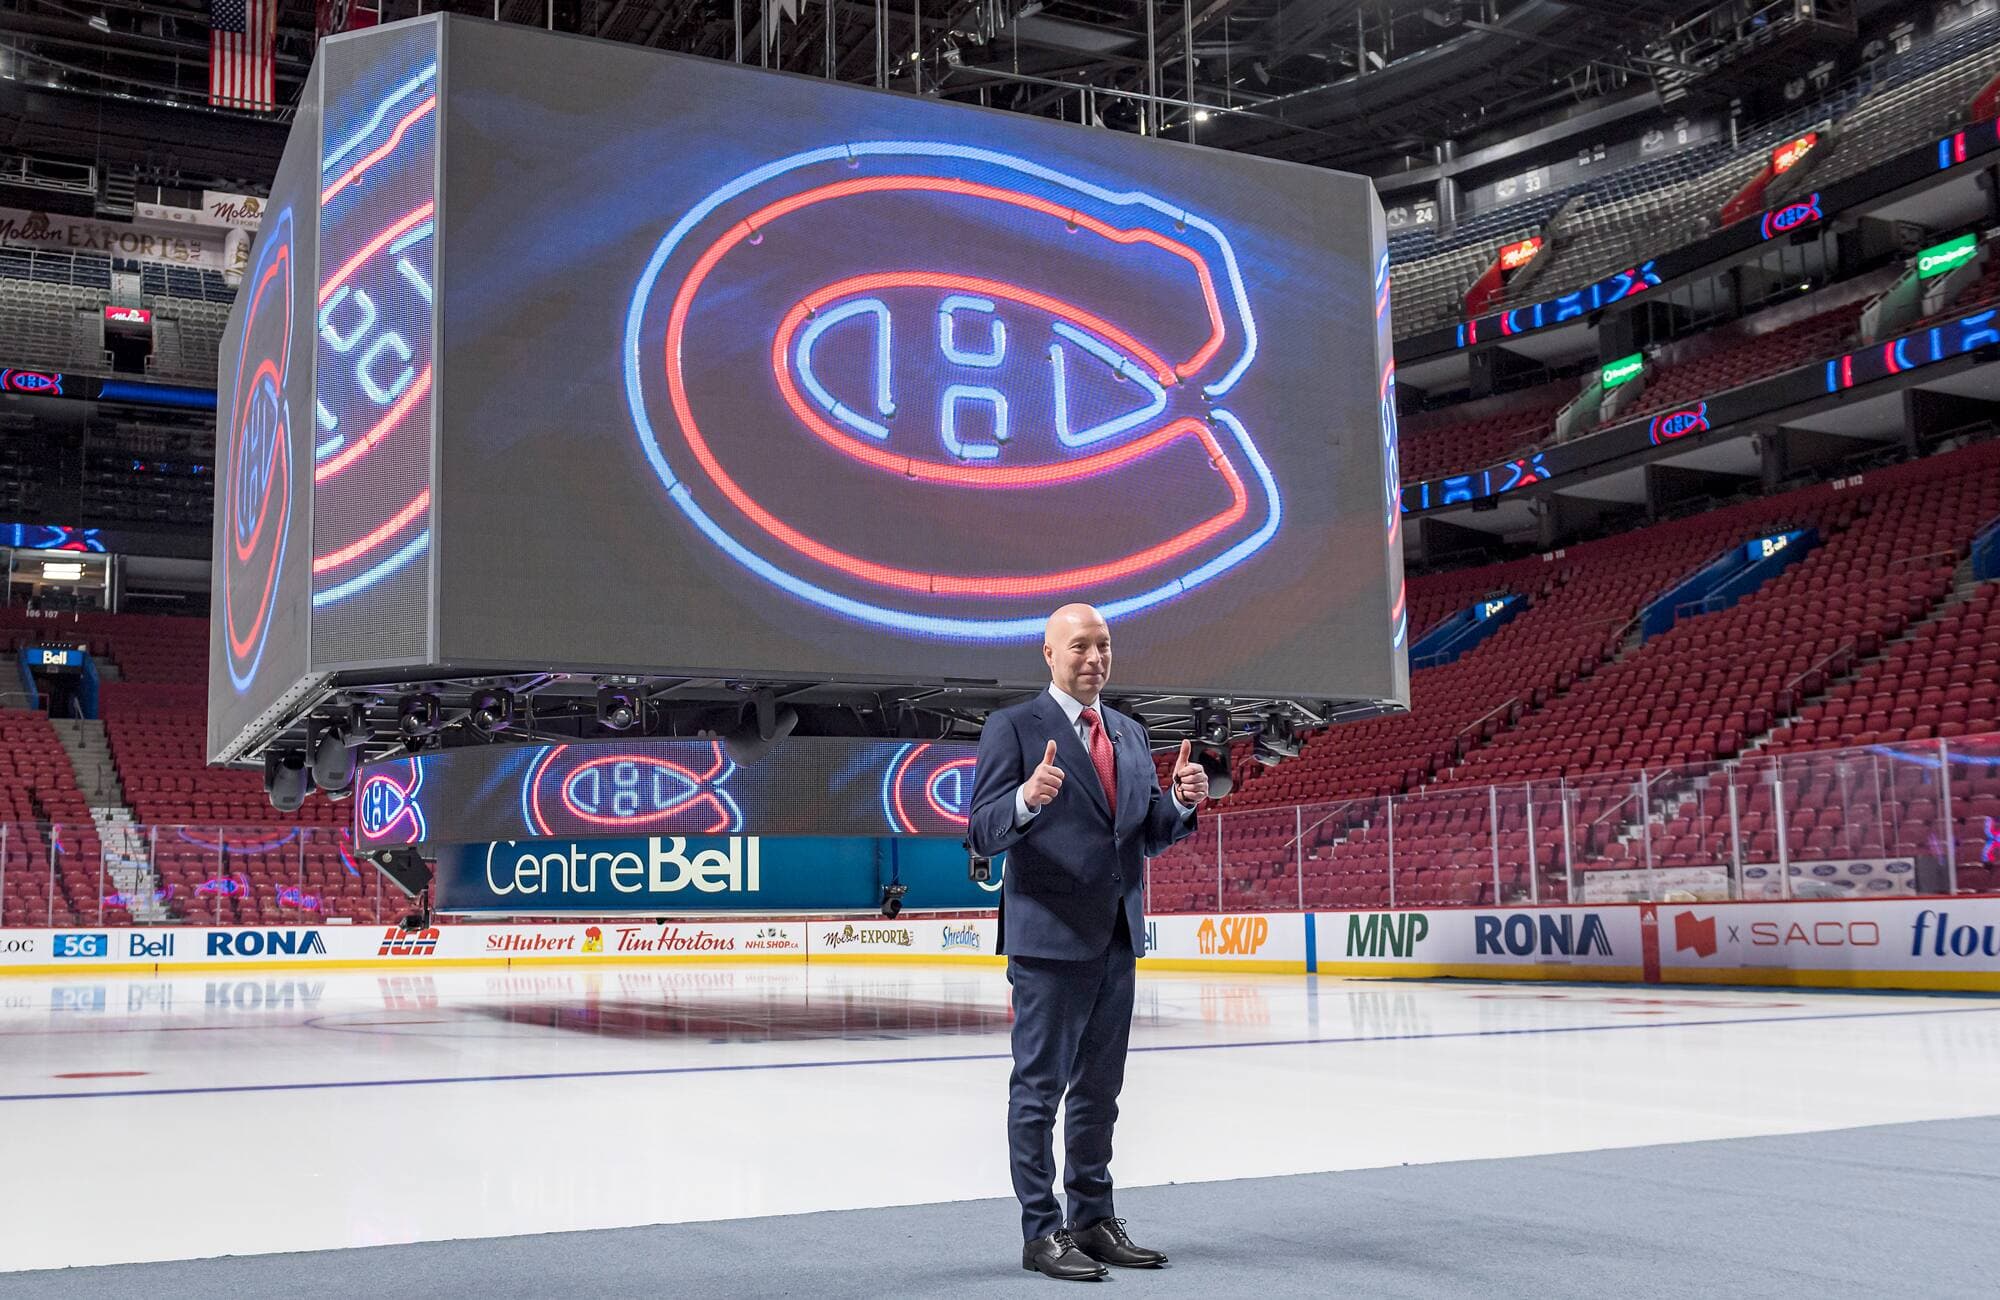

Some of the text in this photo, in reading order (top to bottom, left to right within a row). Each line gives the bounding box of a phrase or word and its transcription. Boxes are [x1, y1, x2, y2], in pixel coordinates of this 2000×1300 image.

[1415, 209, 1432, 225] 24
[67, 223, 174, 258] EXPORT
[43, 650, 68, 665] Bell
[129, 933, 175, 957] Bell
[207, 931, 327, 956] RONA
[378, 928, 440, 956] IGA
[616, 927, 735, 951] Tim Hortons
[861, 930, 904, 944] EXPORT
[942, 925, 980, 948] Shreddies
[1218, 917, 1268, 955] SKIP
[1346, 913, 1429, 958] MNP
[1475, 912, 1614, 957] RONA
[1751, 921, 1880, 947] SACO
[64, 937, 97, 956] 5G
